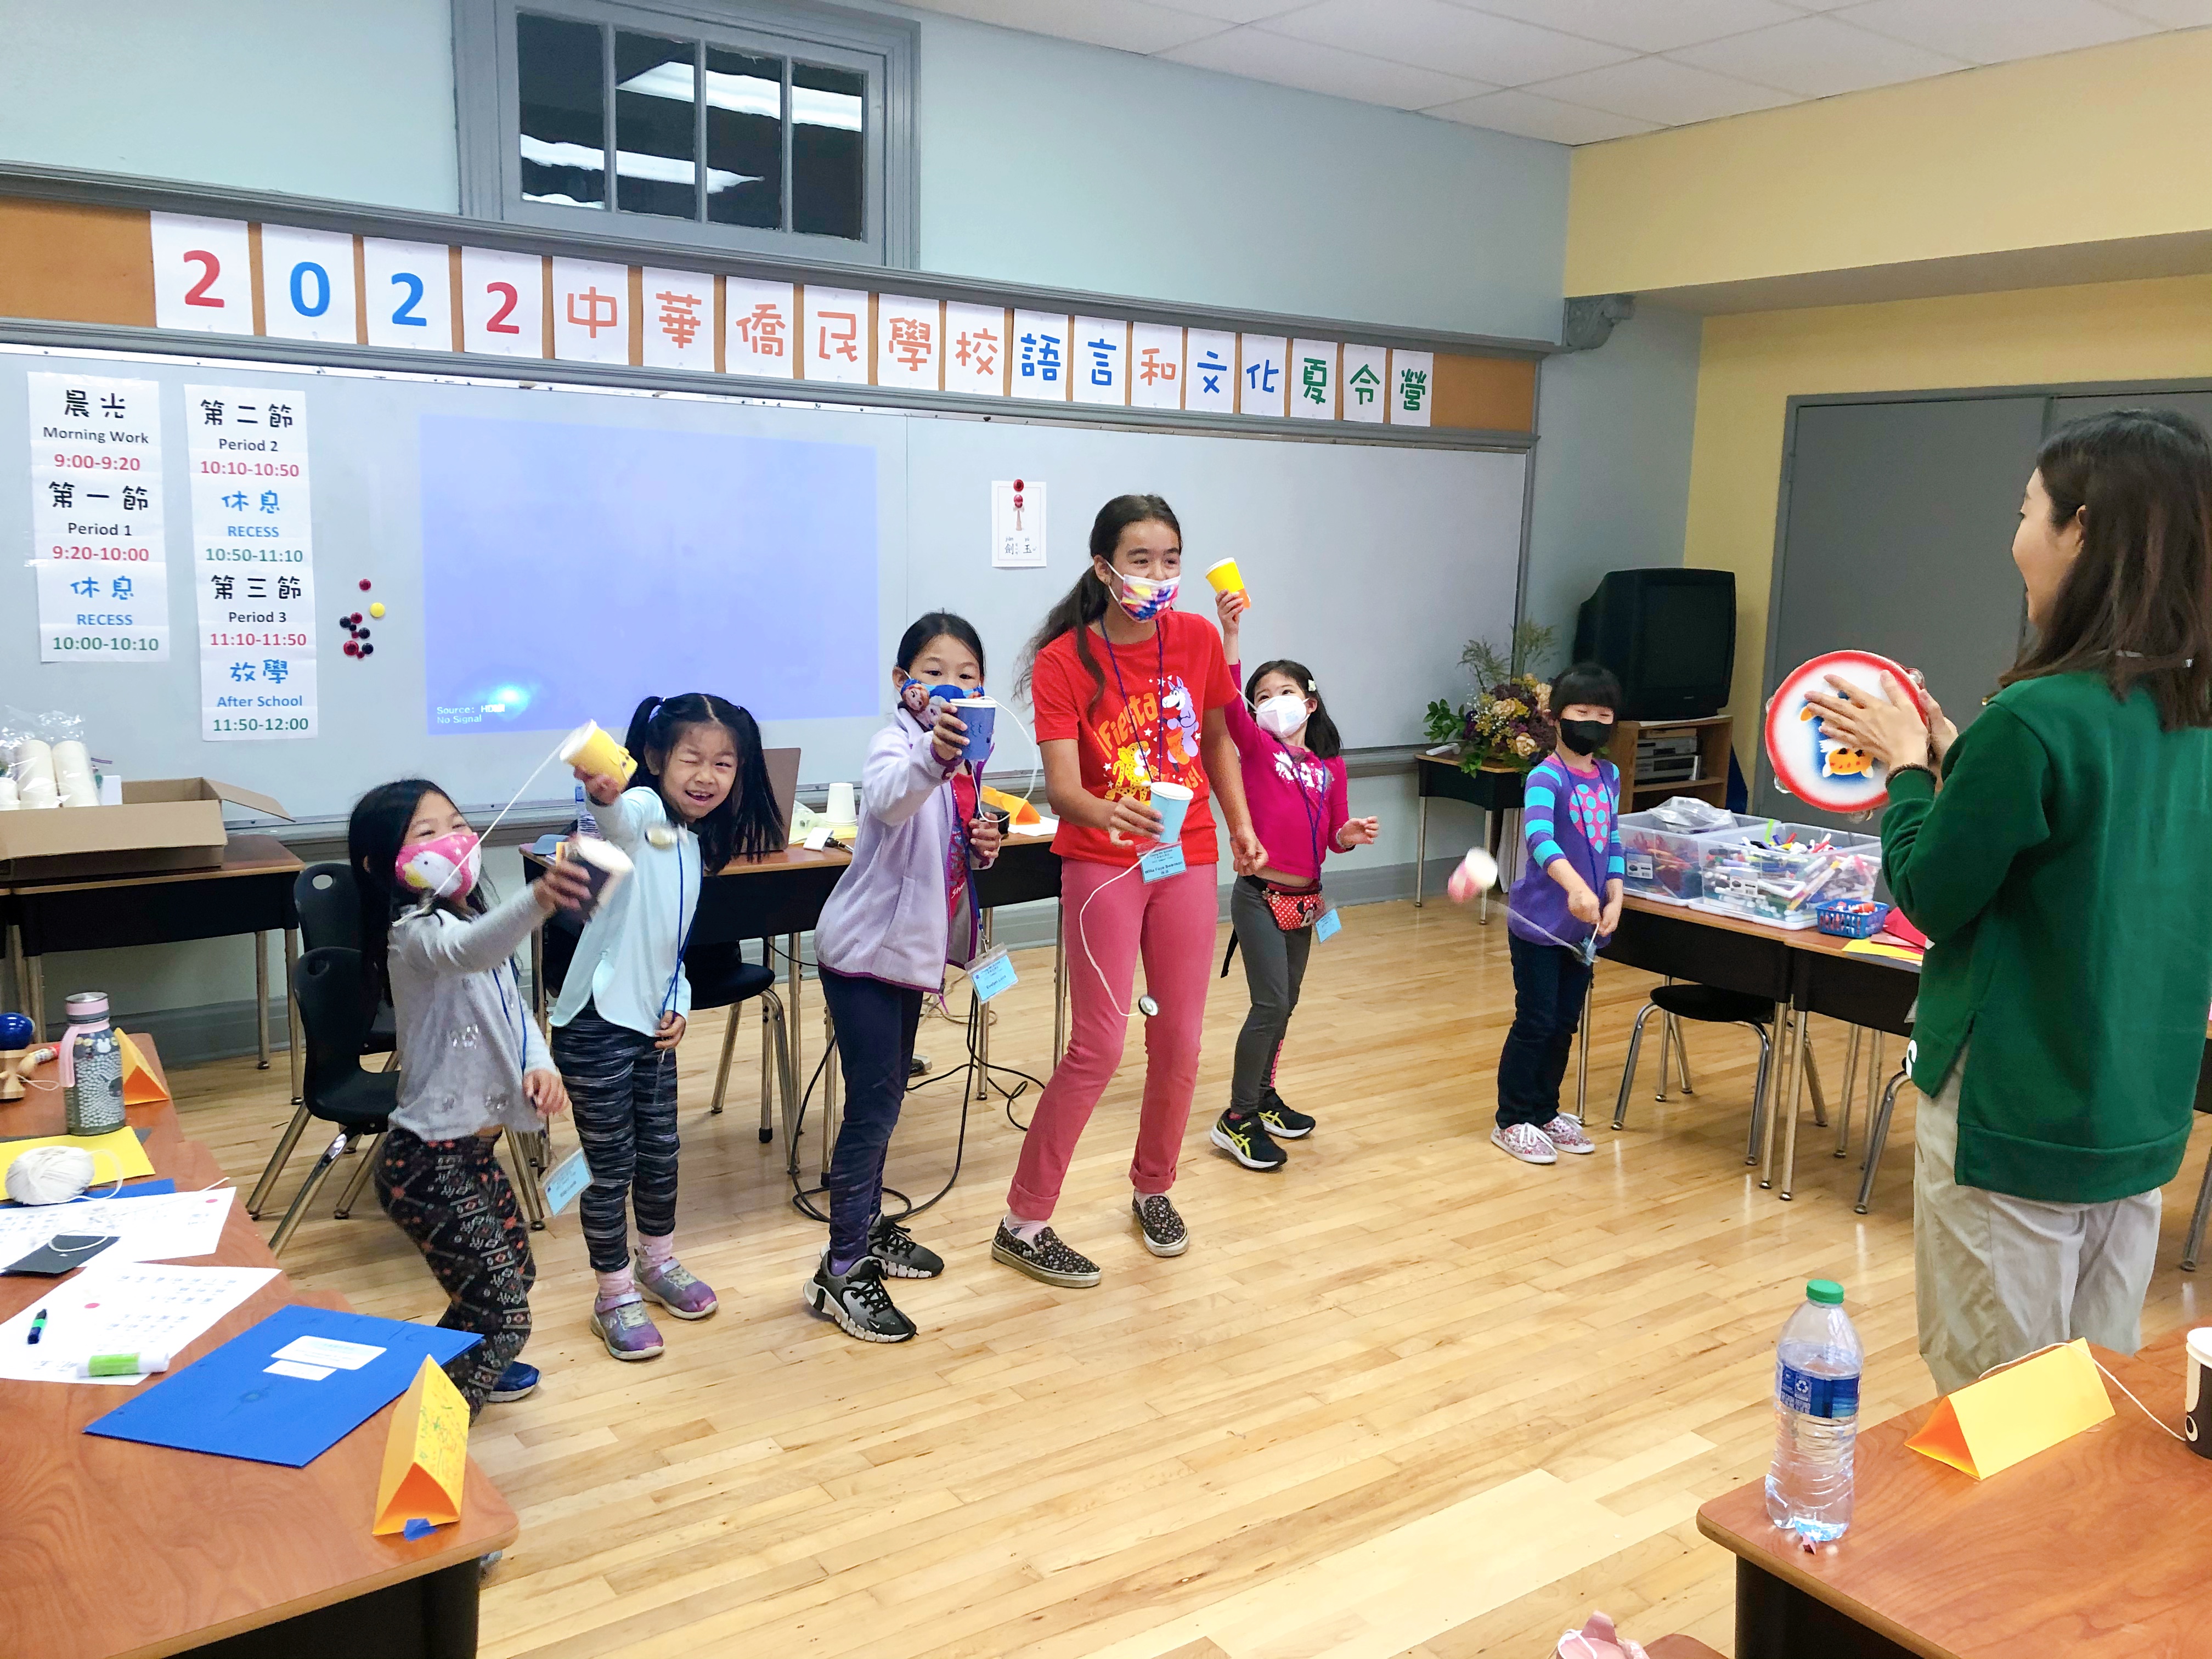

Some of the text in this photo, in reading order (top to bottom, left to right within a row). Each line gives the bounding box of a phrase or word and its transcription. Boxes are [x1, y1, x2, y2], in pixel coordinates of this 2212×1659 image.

[64, 390, 126, 419] 晨光
[200, 399, 292, 428] 第二節
[44, 427, 149, 443] Morning Work
[219, 439, 278, 452] Period 2
[54, 454, 140, 471] 9:00-9:20
[201, 461, 299, 477] 10:10-10:50
[49, 481, 148, 510] 第一節
[222, 490, 280, 514] 休息
[69, 523, 132, 535] Period 1
[228, 526, 279, 537] RECESS
[53, 546, 149, 561] 9:20-10:00
[206, 549, 303, 562] 10:50-11:10
[70, 575, 133, 600] 休息
[211, 575, 301, 600] 第三節
[77, 614, 132, 625] RECESS
[229, 612, 286, 622] Period 3
[54, 637, 159, 651] 10:00-10:10
[211, 634, 306, 645] 11:10-11:50
[230, 659, 288, 684] 放學
[217, 696, 302, 707] After School
[214, 718, 308, 731] 11:50-12:00
[453, 714, 482, 724] Signal
